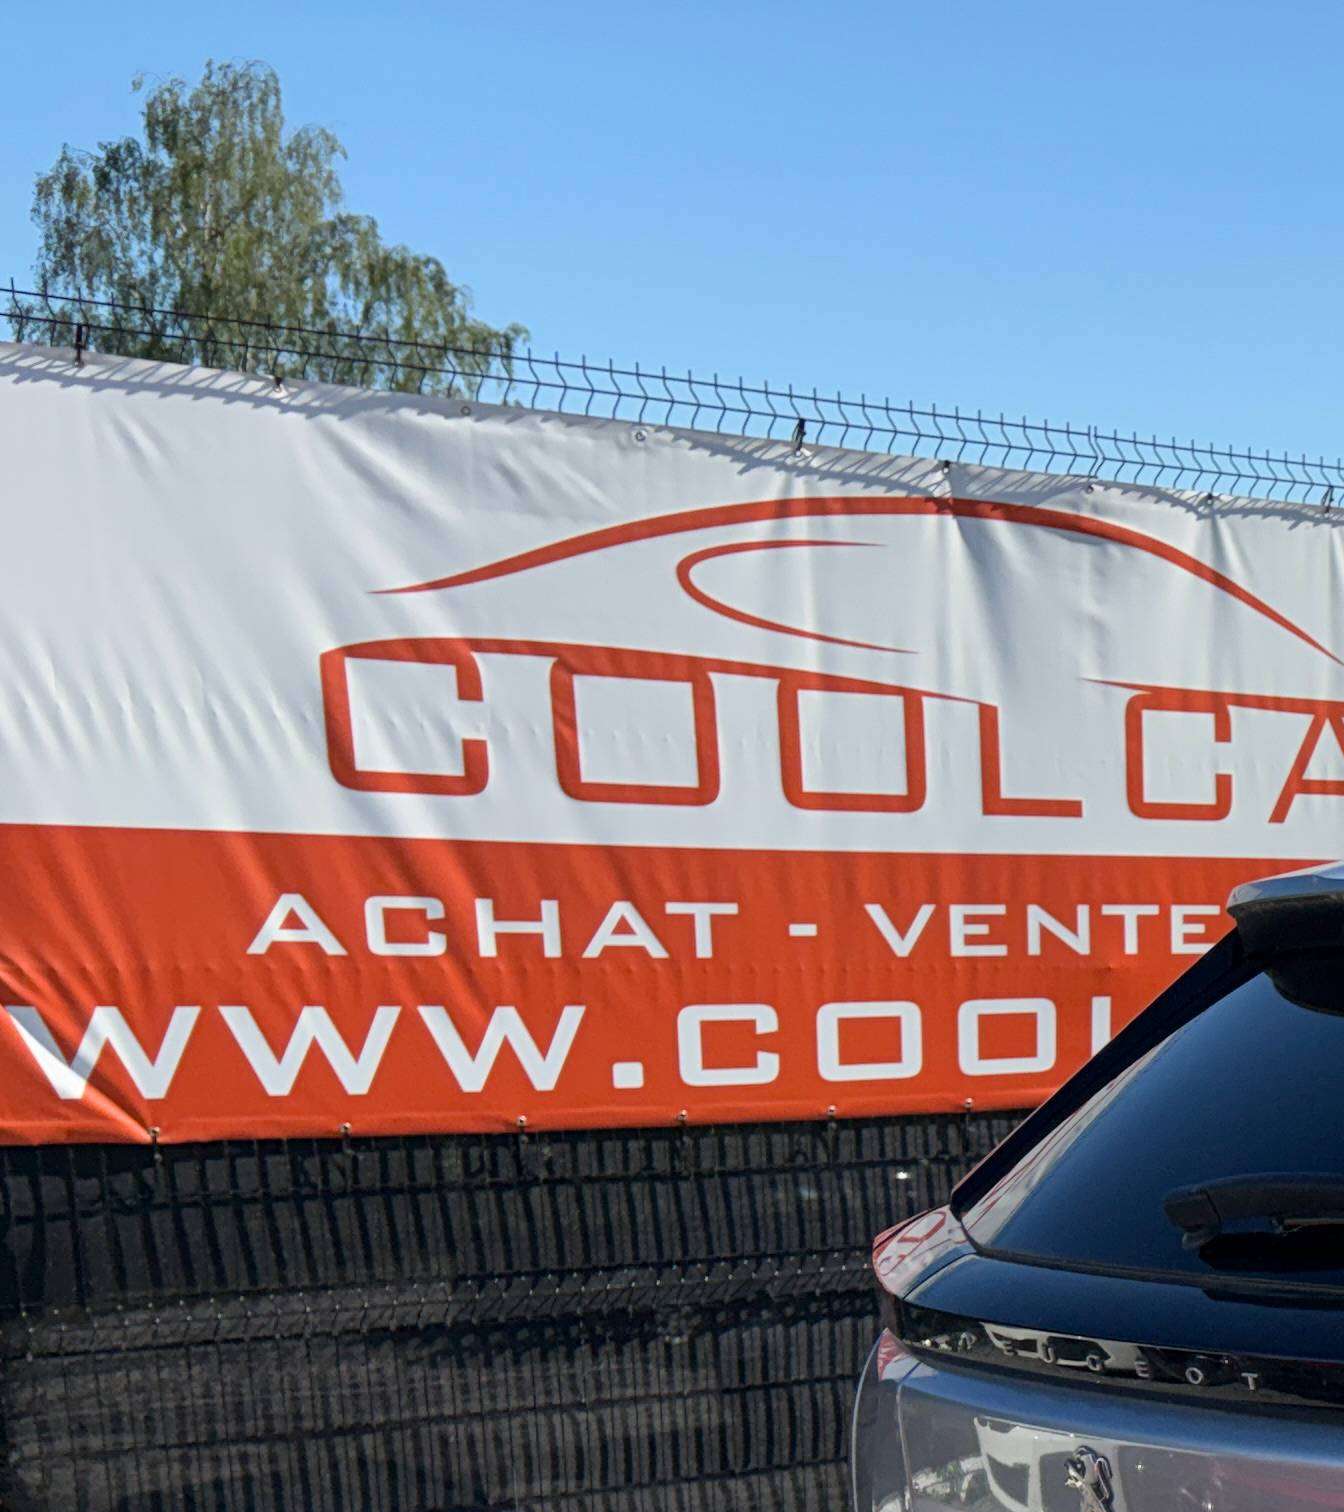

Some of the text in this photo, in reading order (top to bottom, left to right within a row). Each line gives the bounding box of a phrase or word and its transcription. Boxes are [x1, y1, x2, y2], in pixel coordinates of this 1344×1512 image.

[246, 893, 1221, 960] ACHAT - VENTE
